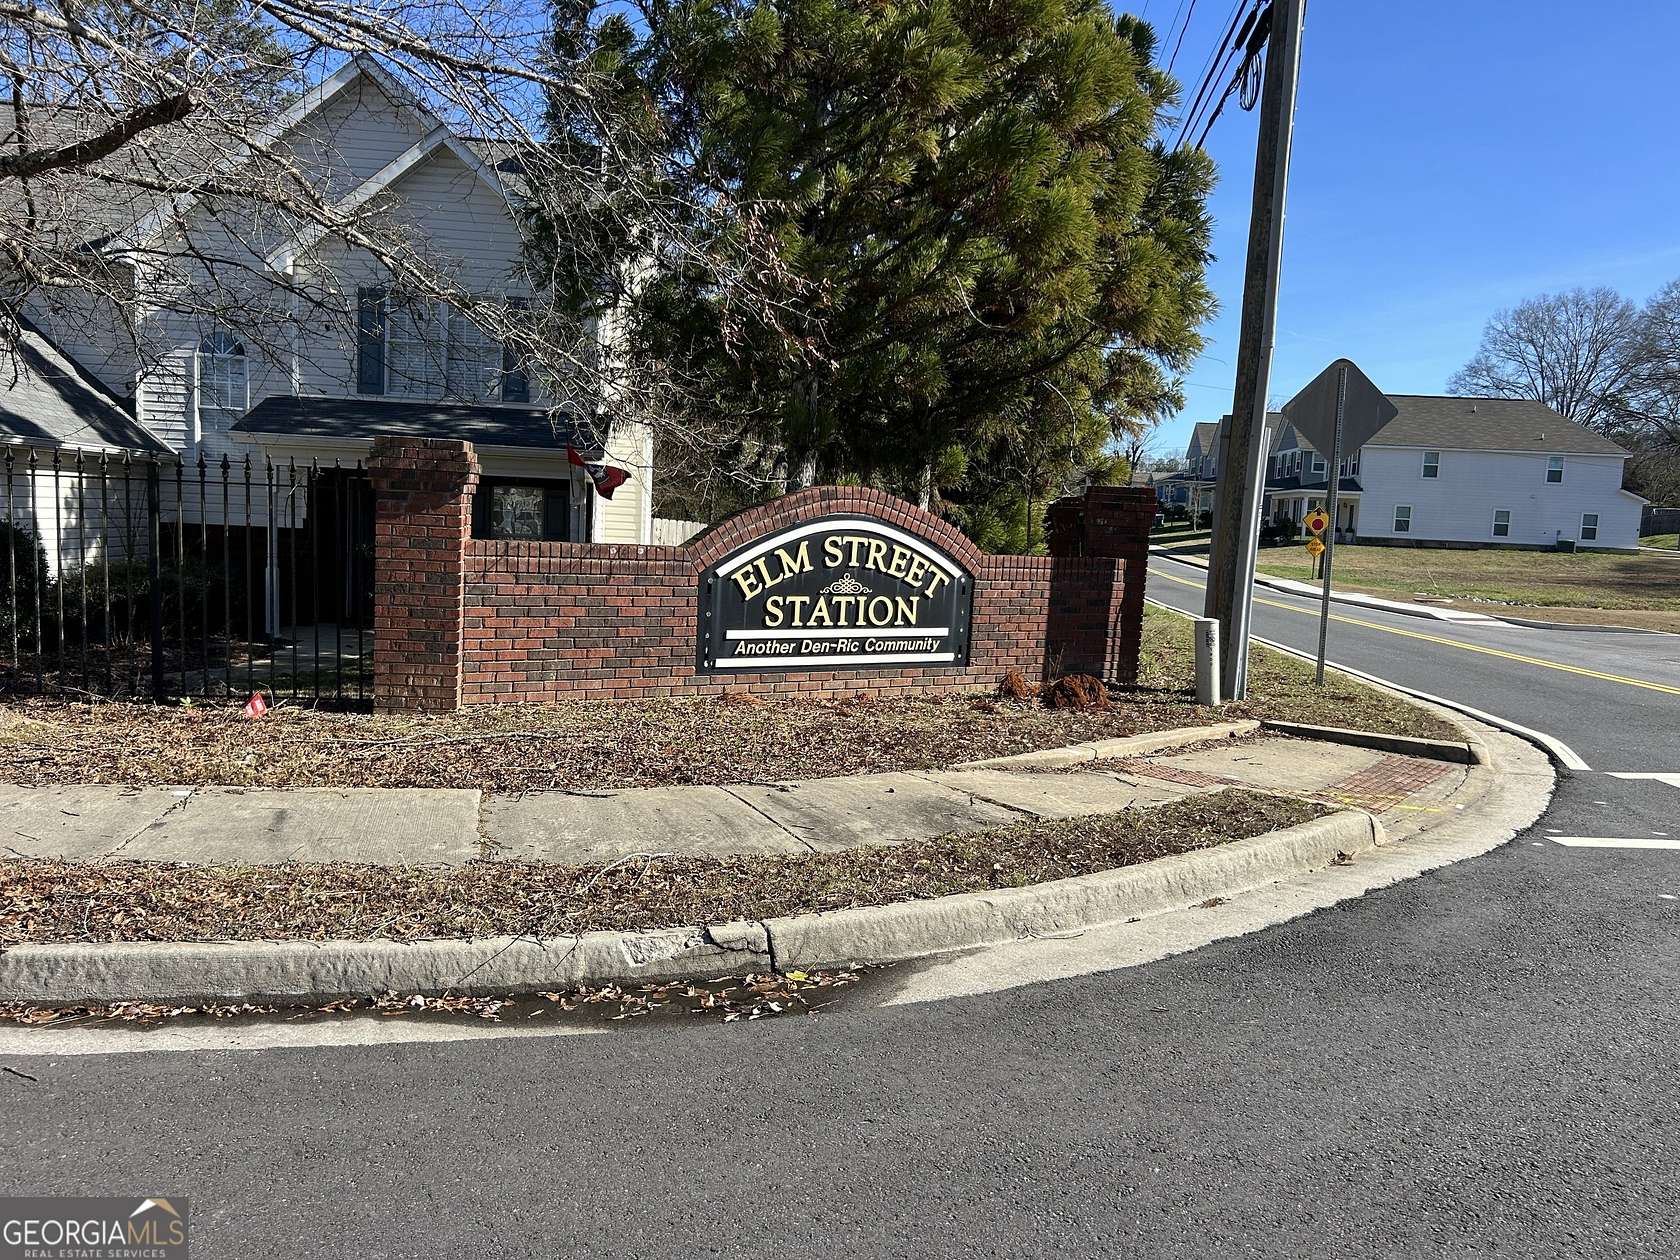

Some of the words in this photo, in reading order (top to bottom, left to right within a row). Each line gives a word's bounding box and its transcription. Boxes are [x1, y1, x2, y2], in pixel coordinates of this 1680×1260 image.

[731, 541, 814, 600] ELM
[824, 536, 949, 599] STREET
[765, 596, 919, 627] STATION
[735, 640, 796, 655] Another
[801, 639, 860, 653] Den-Ric
[864, 638, 941, 653] Community
